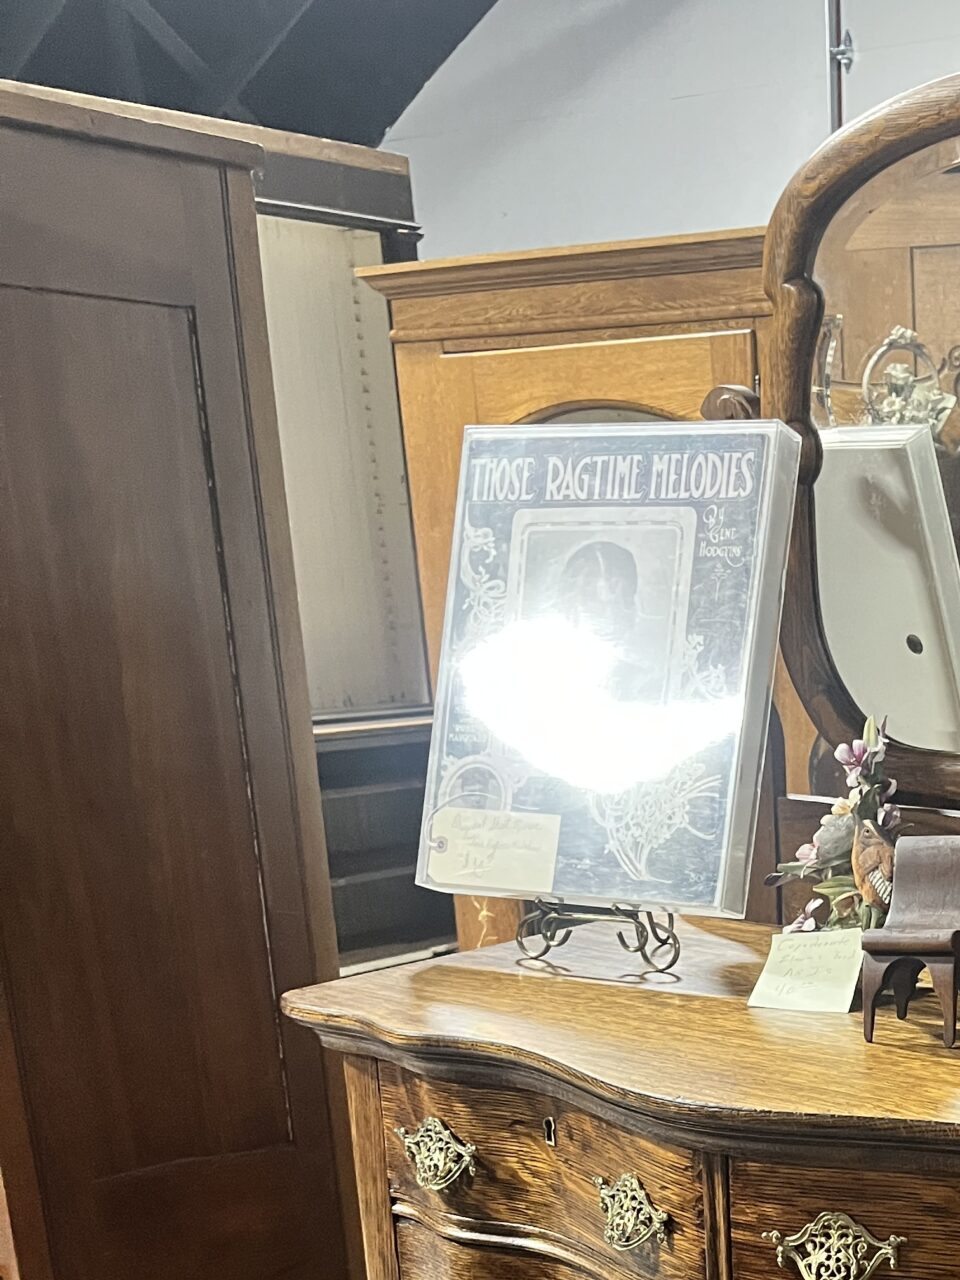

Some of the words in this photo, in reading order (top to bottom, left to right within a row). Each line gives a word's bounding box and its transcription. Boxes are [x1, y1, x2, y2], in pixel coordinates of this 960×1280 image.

[471, 457, 535, 501] THOSE
[544, 455, 643, 501] RAGTIME
[649, 451, 755, 500] MELODIES
